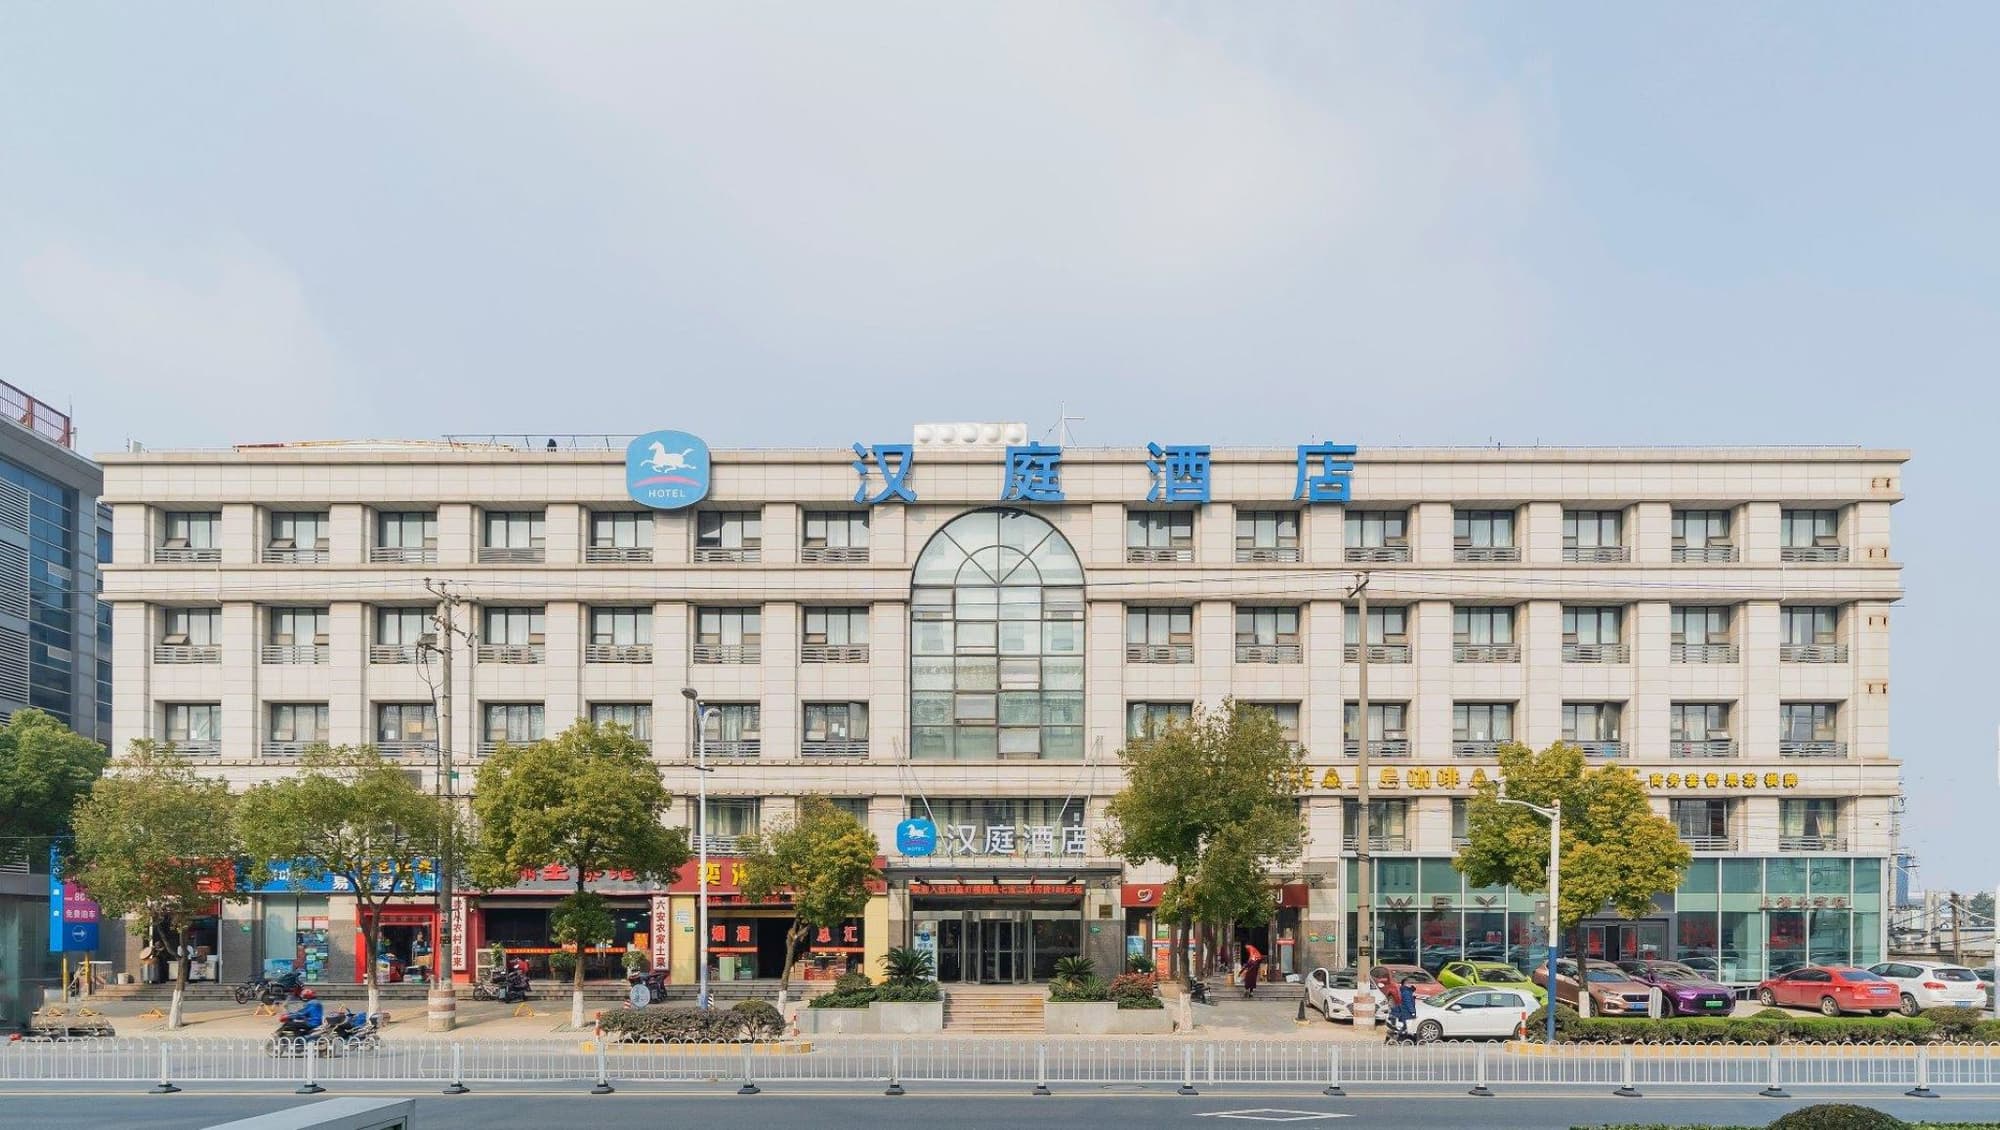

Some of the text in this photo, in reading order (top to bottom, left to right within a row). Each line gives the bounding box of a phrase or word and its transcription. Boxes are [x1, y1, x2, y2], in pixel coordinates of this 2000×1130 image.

[853, 441, 1357, 503] 汉庭酒店
[648, 488, 686, 498] HOTEL
[947, 823, 1087, 854] 汉庭酒店
[1386, 895, 1498, 909] WEY
[655, 900, 666, 968] 六安农家土菜
